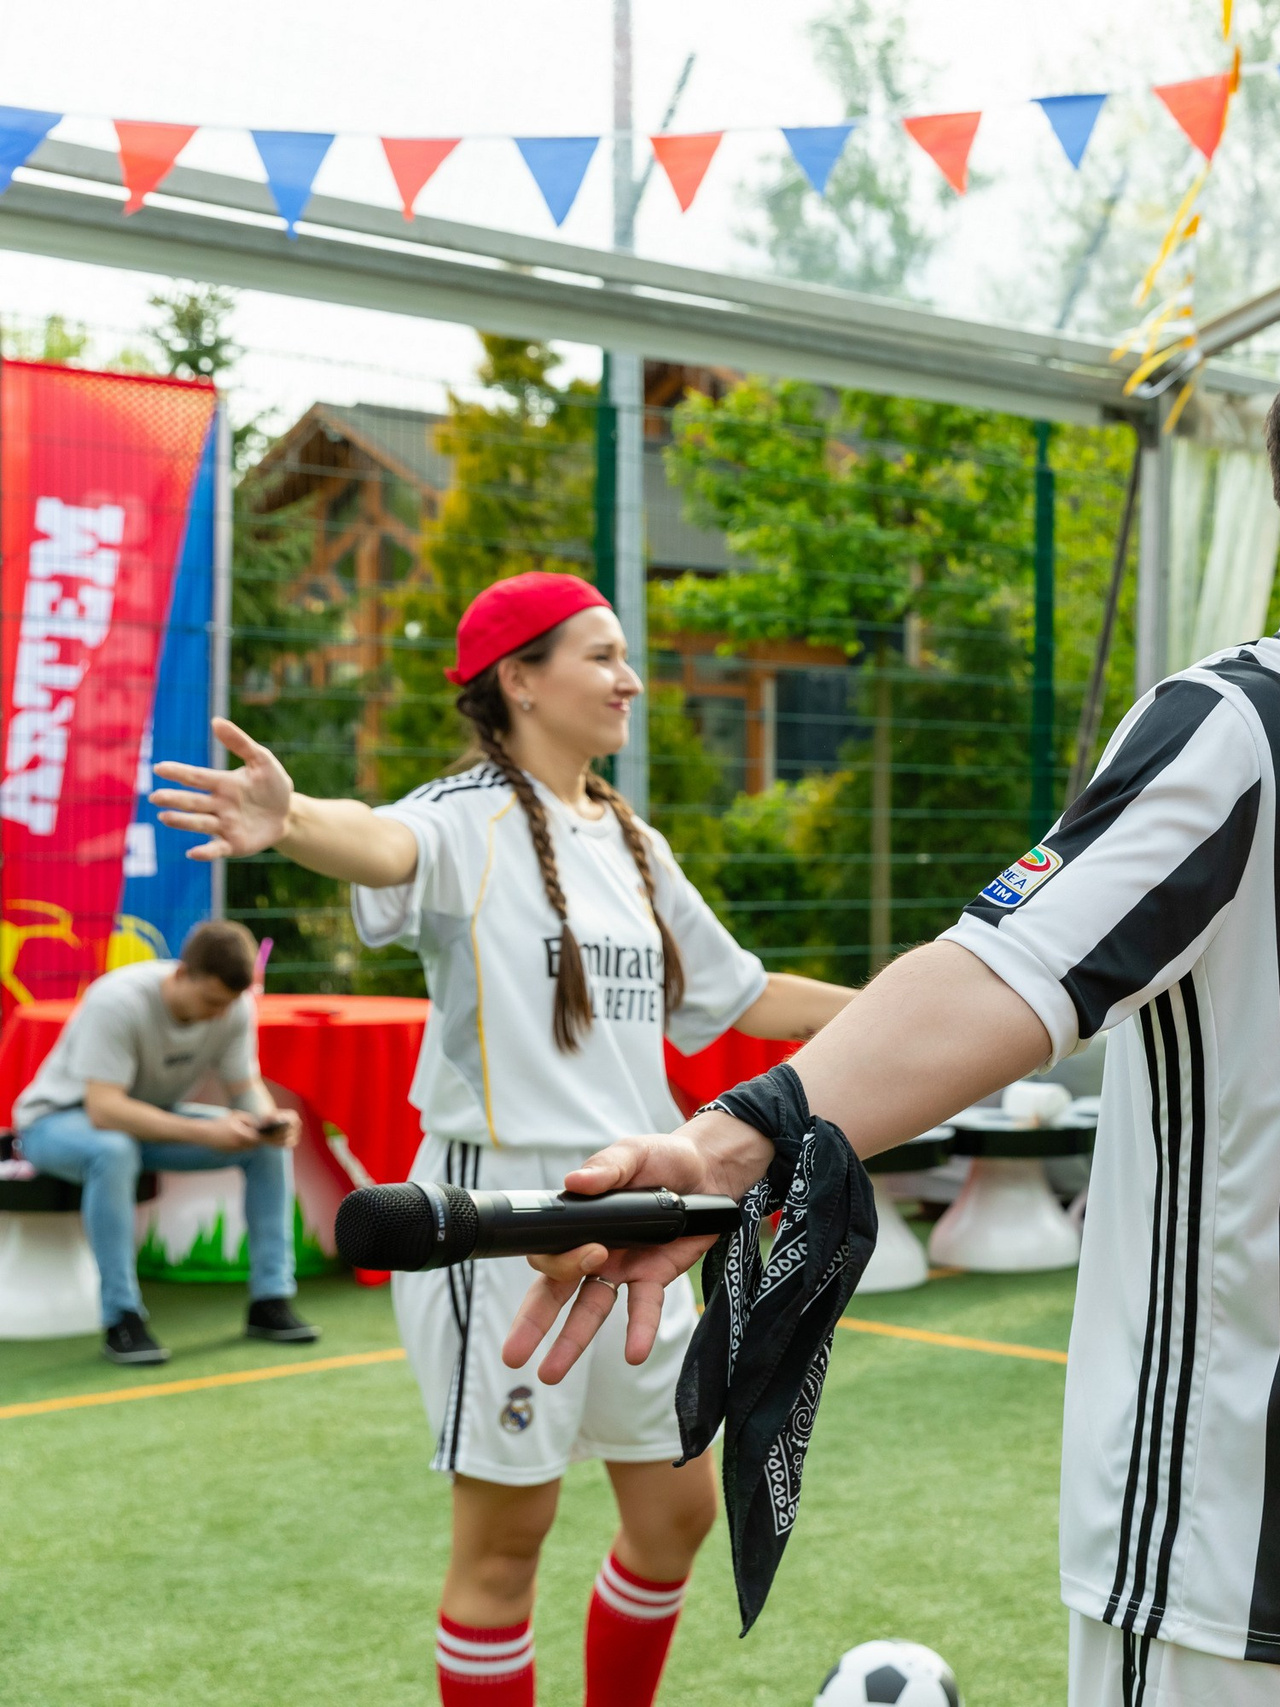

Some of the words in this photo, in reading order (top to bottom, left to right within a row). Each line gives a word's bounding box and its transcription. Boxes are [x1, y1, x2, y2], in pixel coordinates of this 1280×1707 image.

[1, 497, 125, 835] ARTEM
[988, 881, 1012, 901] TIM
[543, 936, 663, 979] Emirat
